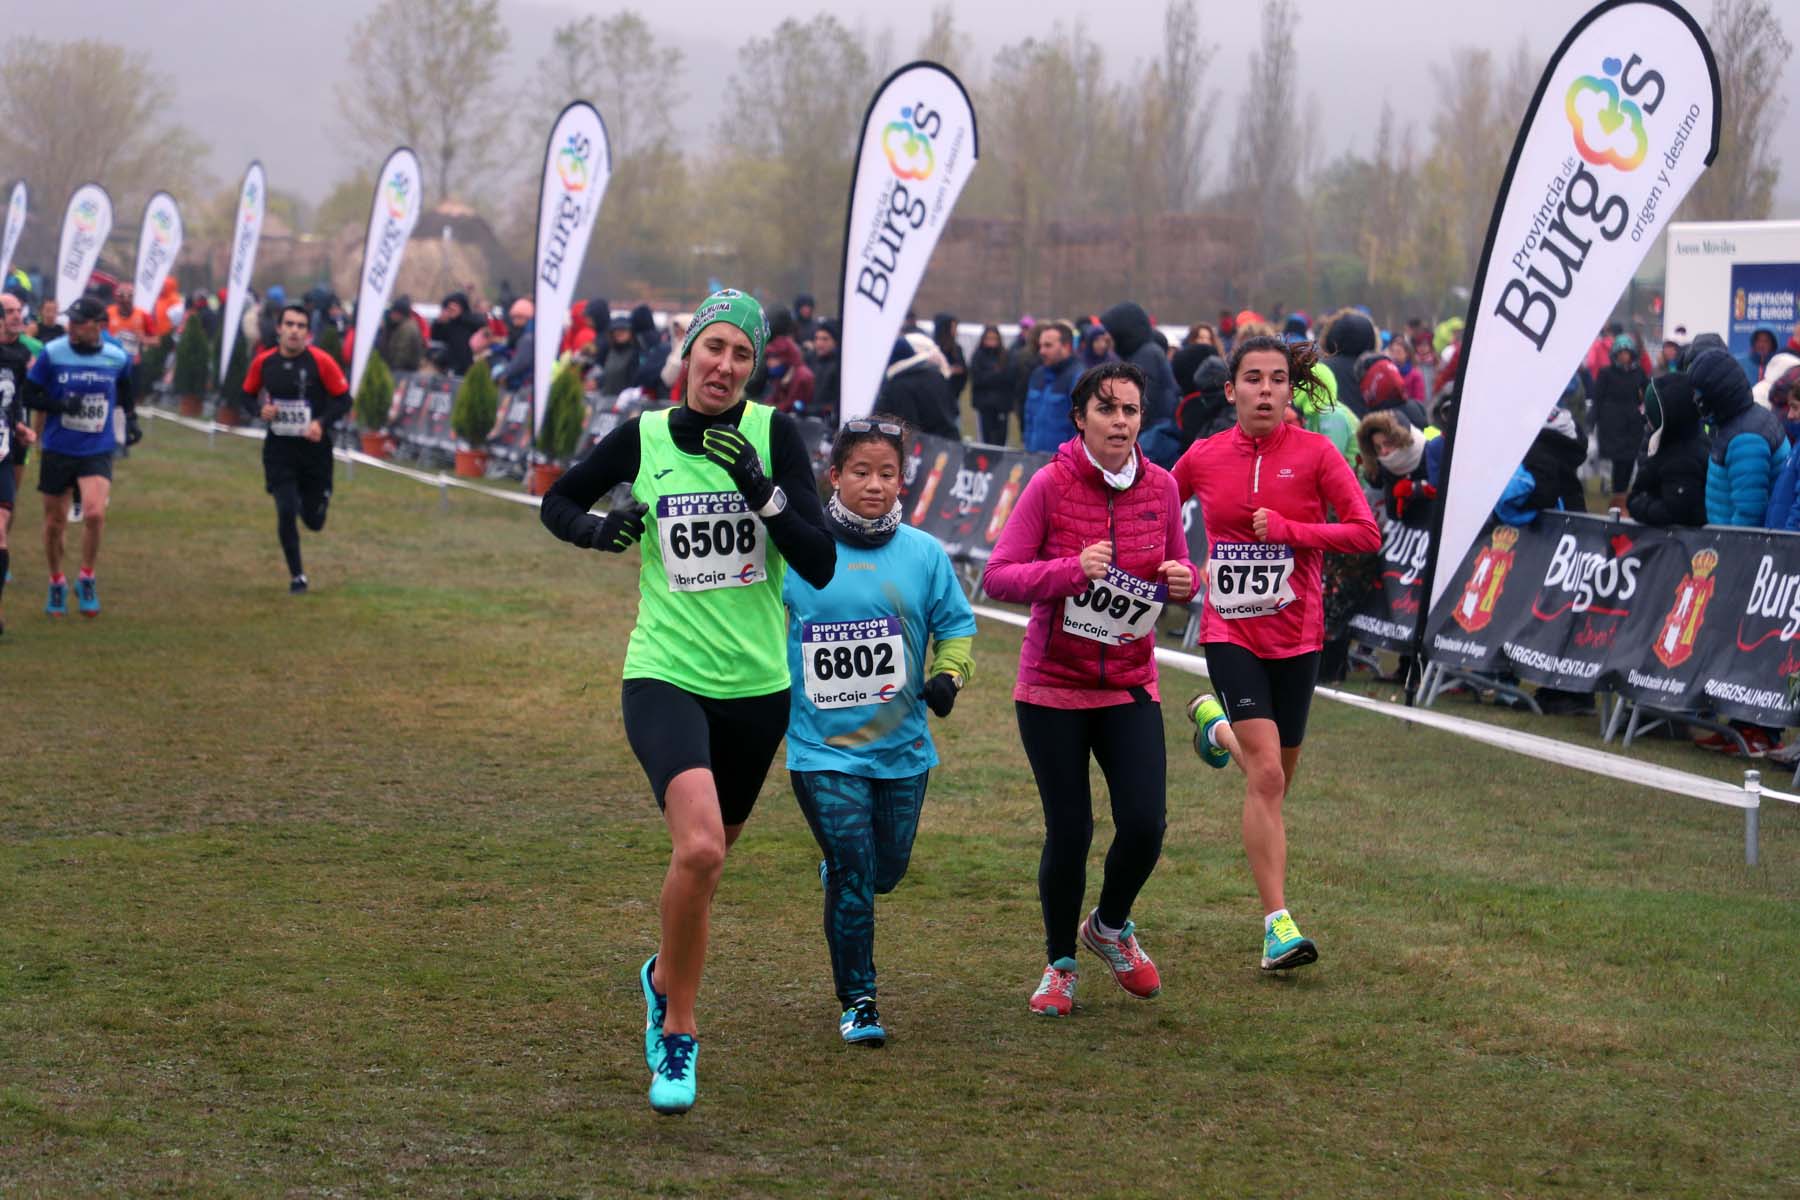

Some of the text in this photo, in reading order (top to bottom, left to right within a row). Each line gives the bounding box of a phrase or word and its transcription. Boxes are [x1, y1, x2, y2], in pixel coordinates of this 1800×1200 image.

[1631, 104, 1701, 242] origen y destino
[1512, 156, 1577, 271] Provincia de
[670, 519, 756, 560] 6508
[1217, 551, 1286, 560] BURGOS
[675, 571, 726, 585] iberCaja
[1107, 565, 1157, 593] UTACIÓN
[1218, 564, 1286, 595] 6757
[1544, 534, 1641, 613] Burgos
[1109, 575, 1155, 600] RGOS
[1216, 605, 1263, 614] iberCaja
[812, 619, 888, 632] DIPUTACIÓN
[812, 628, 890, 642] BURGOS
[1064, 616, 1109, 638] berCaja
[814, 643, 895, 681] 6802
[814, 691, 867, 703] iberCaja
